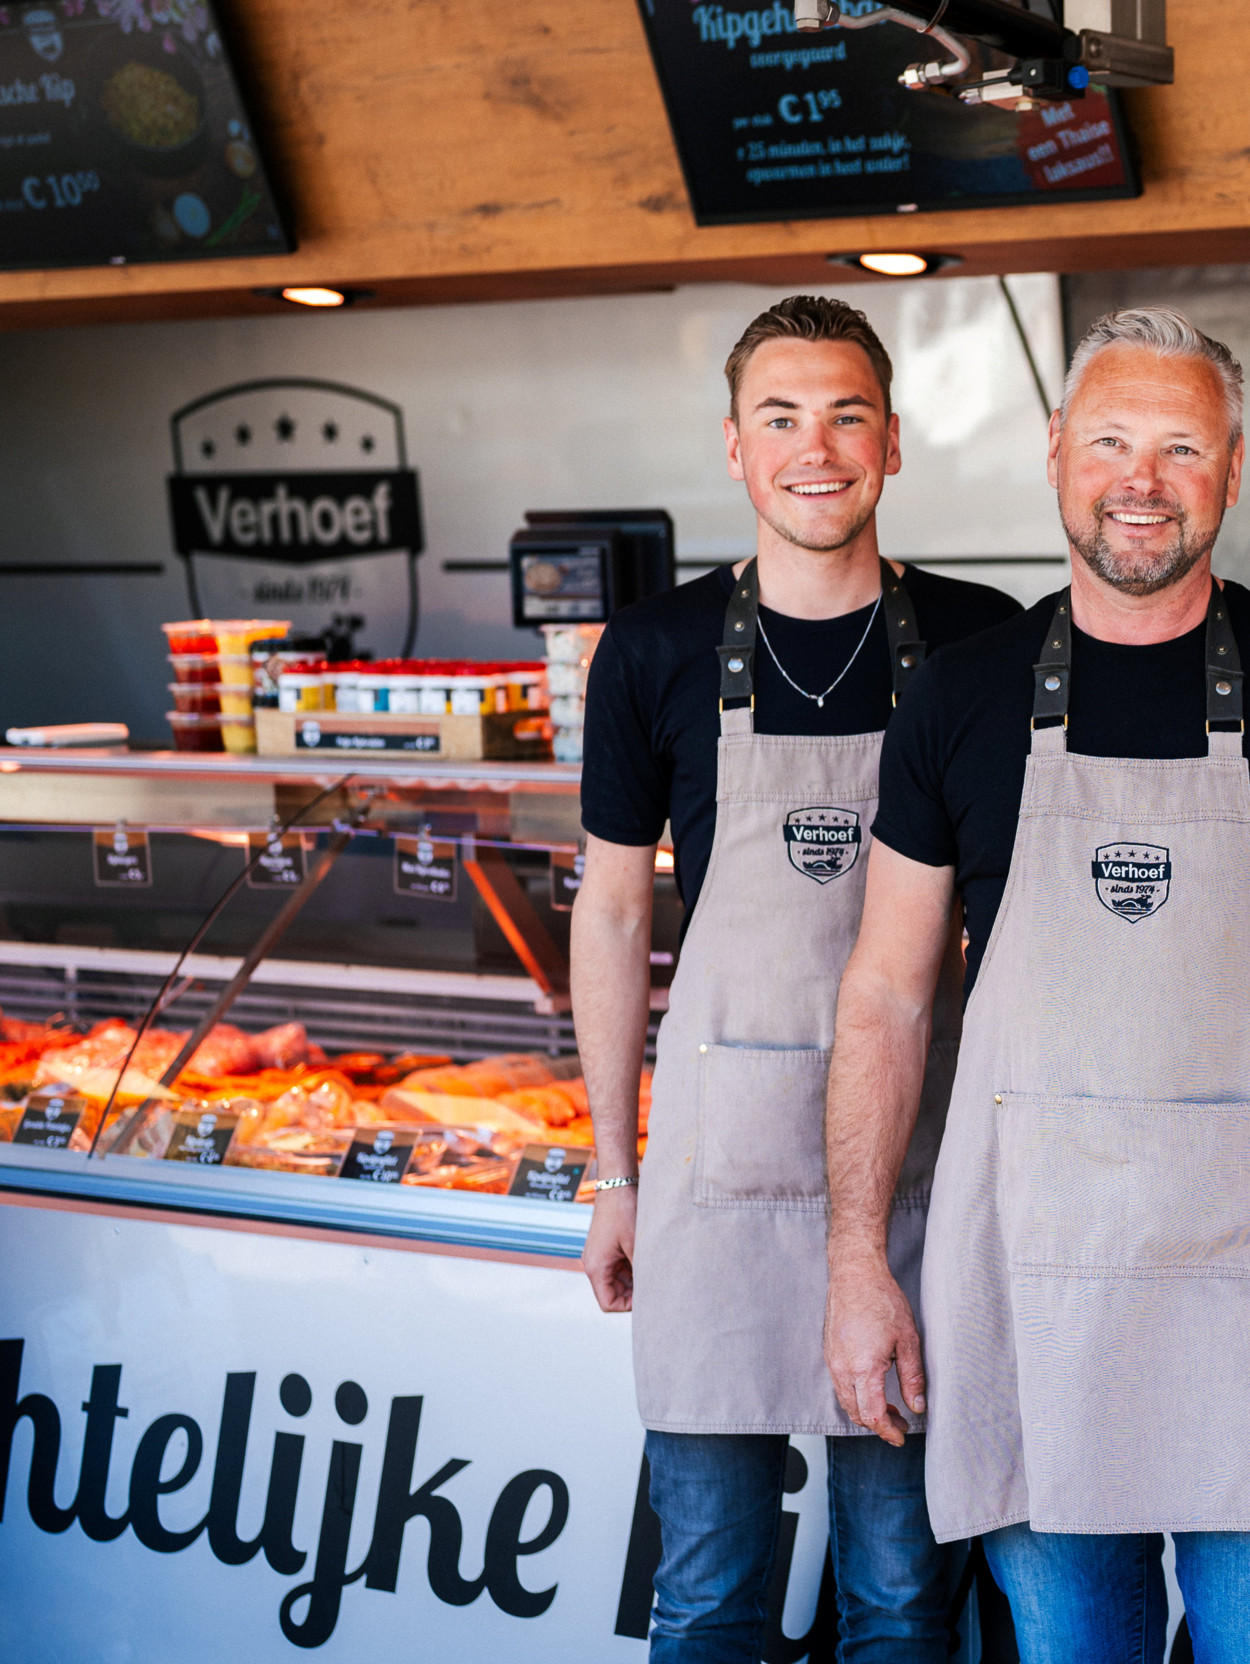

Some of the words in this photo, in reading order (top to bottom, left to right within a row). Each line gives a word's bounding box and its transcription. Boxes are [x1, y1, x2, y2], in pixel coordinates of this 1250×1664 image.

[1041, 101, 1075, 128] Met
[1057, 120, 1111, 150] Thaise
[196, 482, 392, 545] Verhoef
[792, 826, 855, 842] Verhoef
[802, 847, 824, 856] sinds
[1101, 862, 1165, 879] Verhoef
[1110, 884, 1133, 893] sinds
[1135, 884, 1155, 895] 1974
[0, 1339, 570, 1649] htelijke
